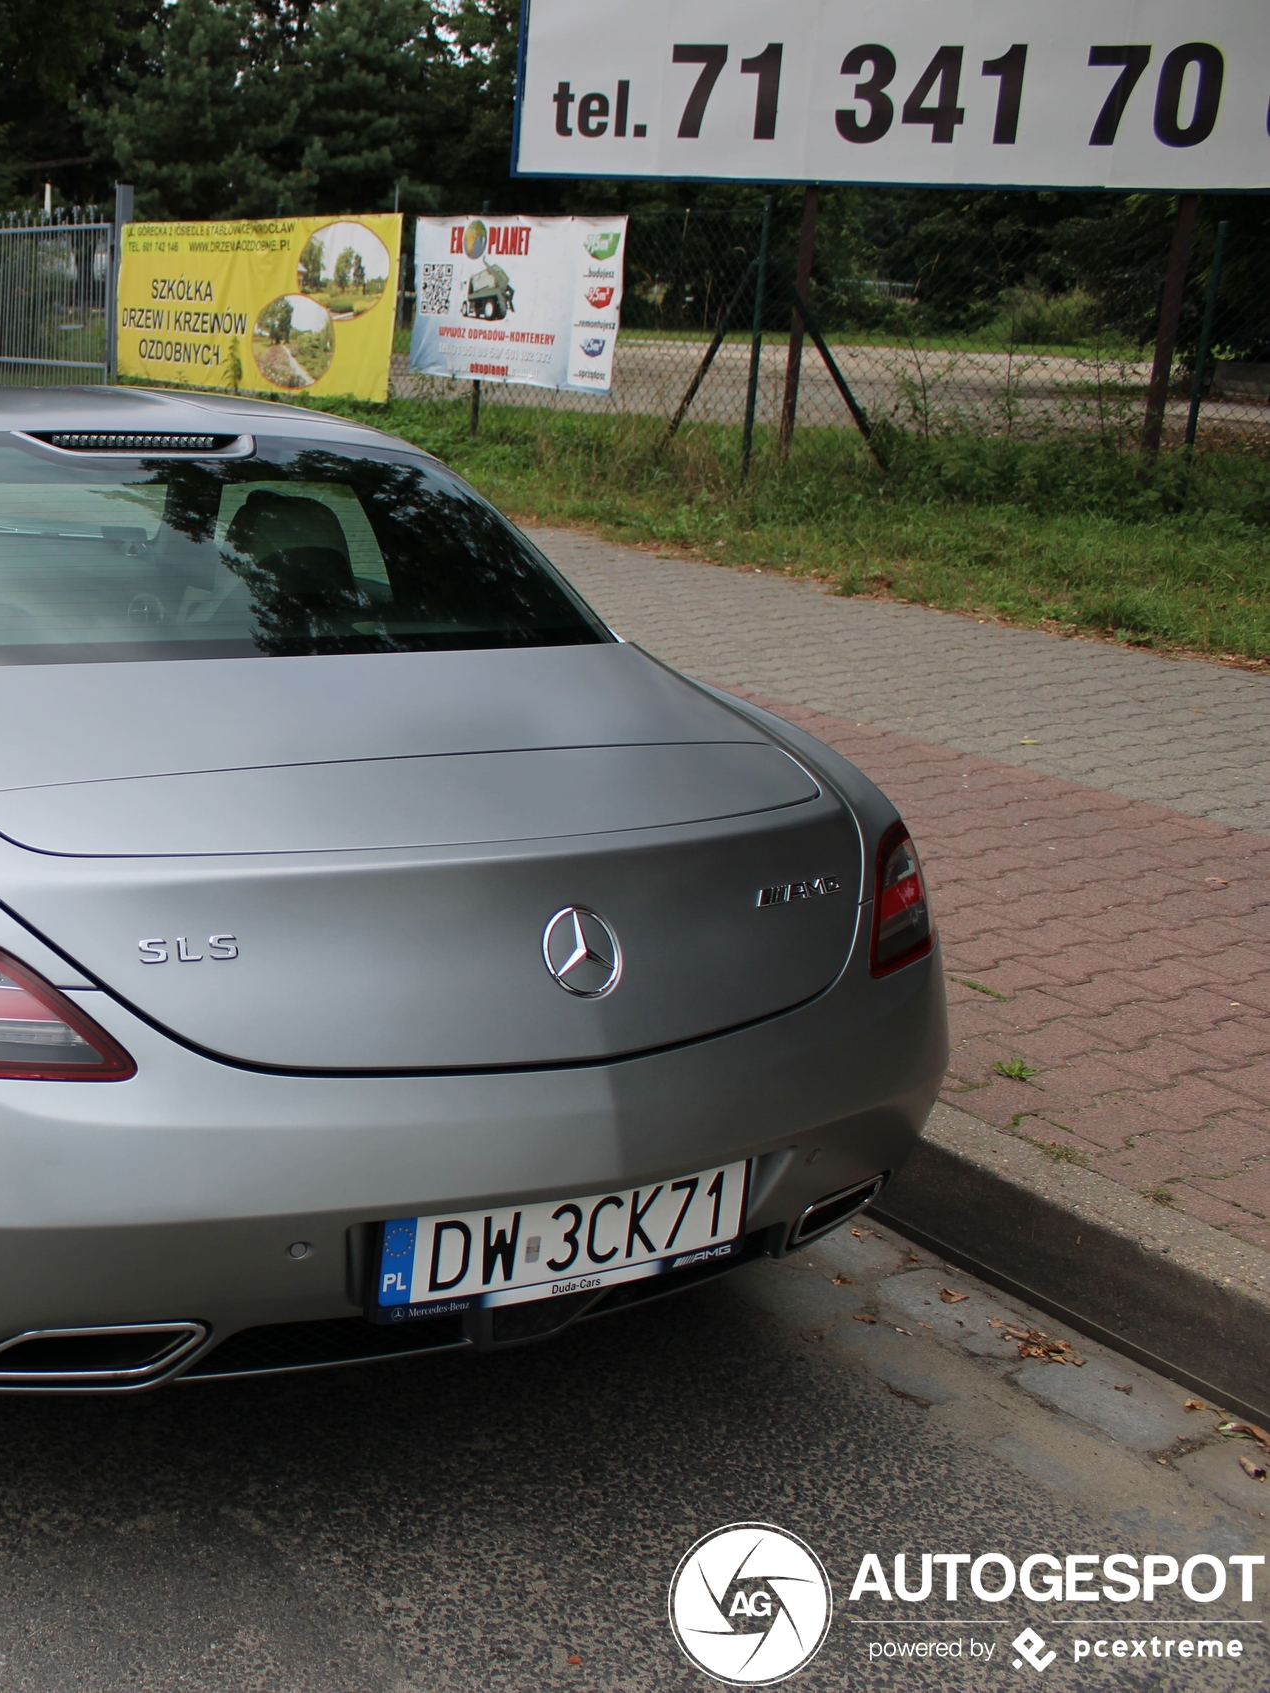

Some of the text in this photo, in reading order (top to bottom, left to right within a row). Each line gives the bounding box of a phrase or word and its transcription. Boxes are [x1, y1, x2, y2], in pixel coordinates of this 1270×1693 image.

[552, 79, 648, 139] tel.
[671, 43, 784, 141] 71
[834, 43, 1029, 145] 341
[1086, 42, 1226, 148] 70
[487, 226, 532, 256] PLANET
[151, 273, 213, 302] SZKÓŁKA
[122, 306, 248, 335] DRZEW I KRZEWÓW
[438, 325, 466, 339] WYWÓZ
[138, 338, 220, 366] OZDOBNYCH
[138, 934, 239, 965] SLS
[382, 1170, 725, 1293] PL DW 3CK71
[691, 1244, 732, 1263] AMG
[551, 1277, 601, 1294] Duda-Cars
[408, 1301, 470, 1318] Mercedes-Benz
